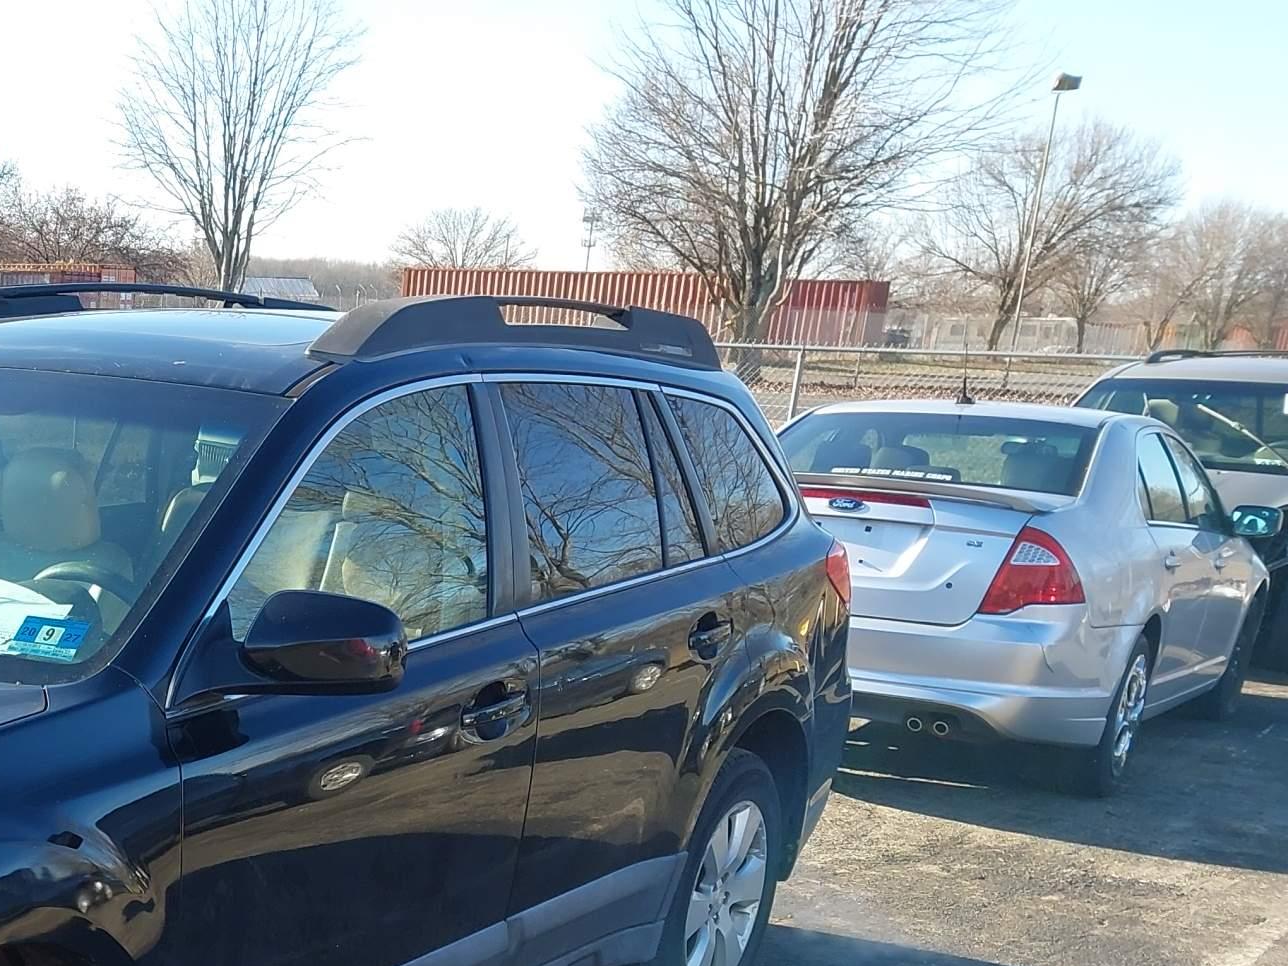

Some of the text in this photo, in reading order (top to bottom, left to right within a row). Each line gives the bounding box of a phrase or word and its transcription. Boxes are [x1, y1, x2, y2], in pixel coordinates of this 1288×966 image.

[20, 626, 37, 637] 20
[42, 627, 56, 642] 9
[63, 632, 81, 642] 27
